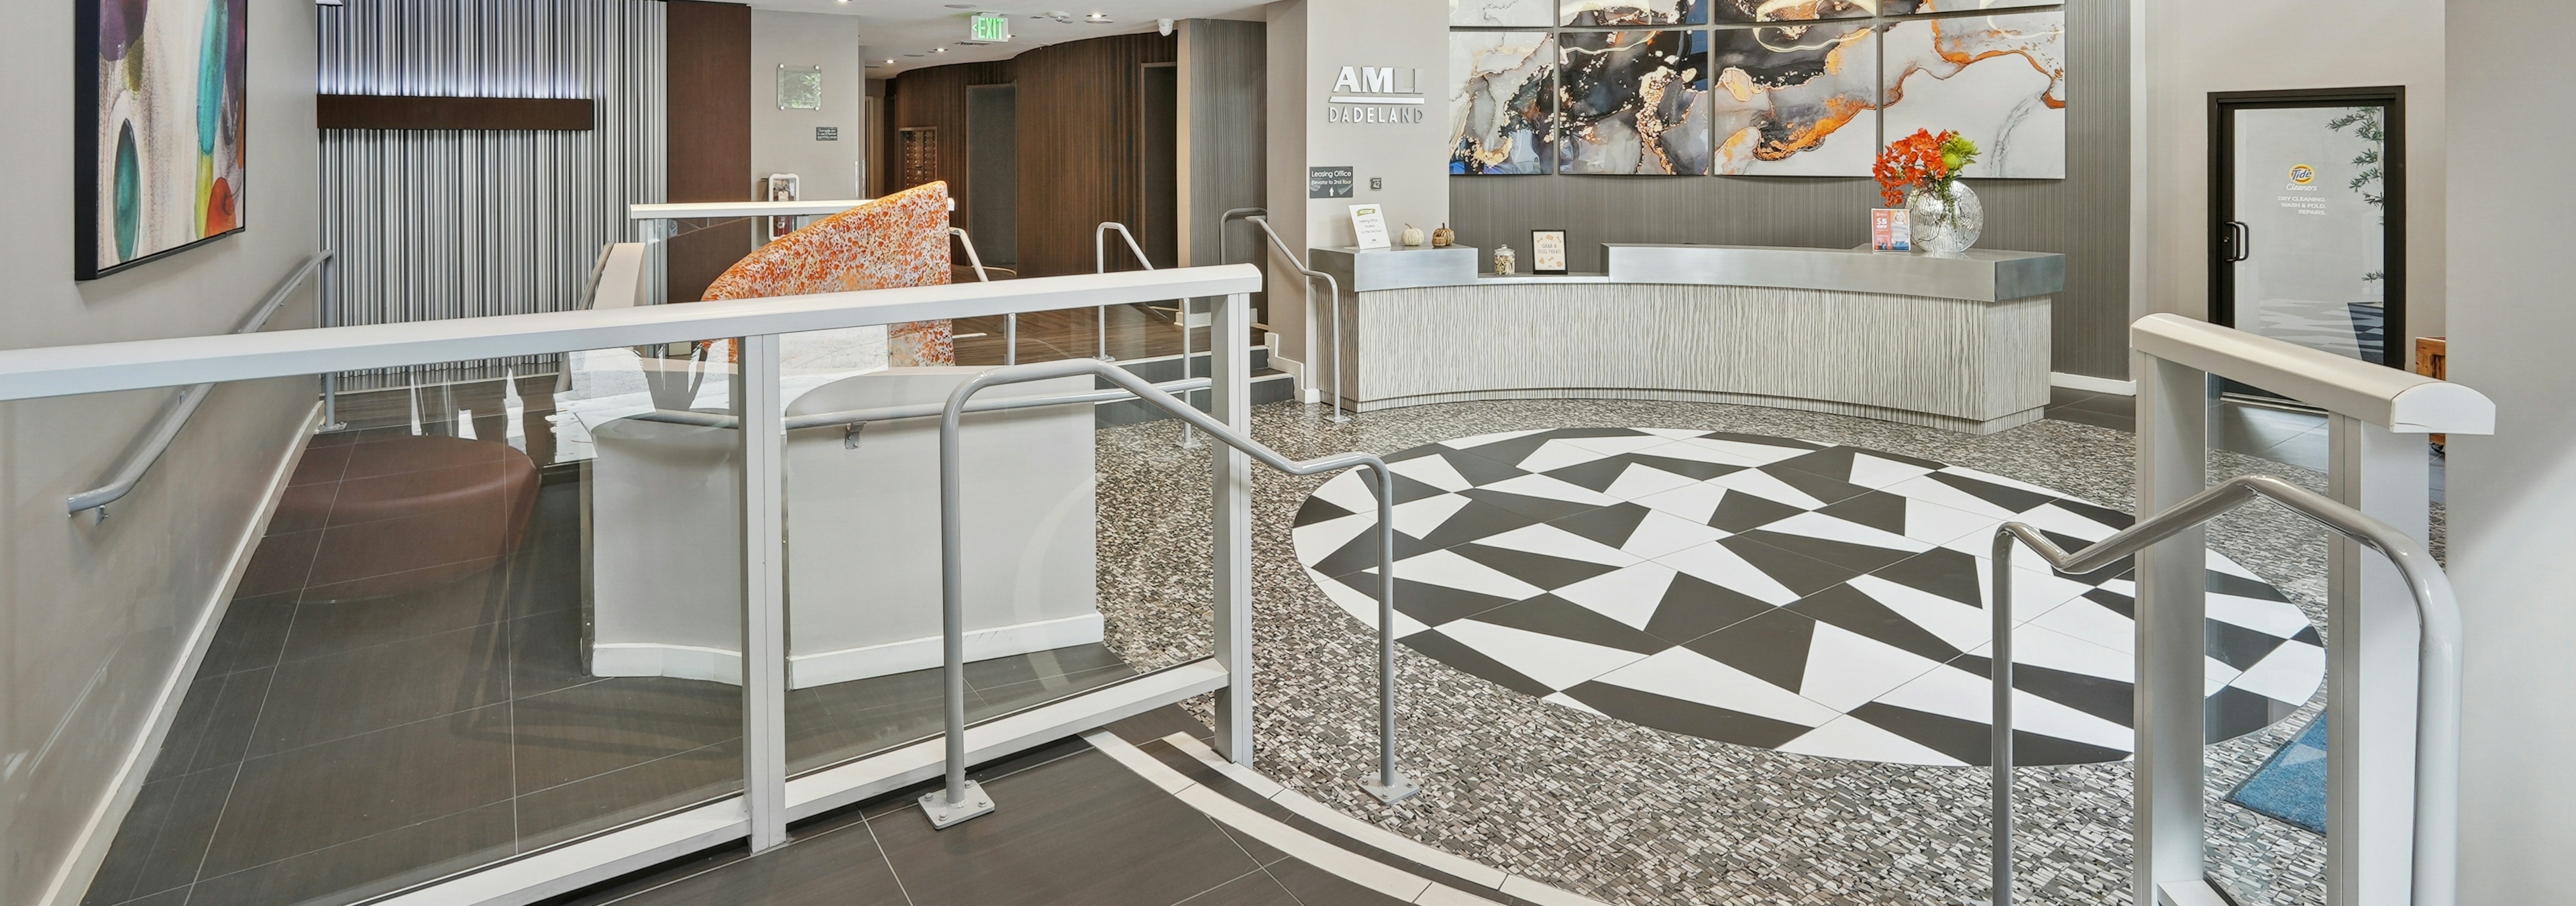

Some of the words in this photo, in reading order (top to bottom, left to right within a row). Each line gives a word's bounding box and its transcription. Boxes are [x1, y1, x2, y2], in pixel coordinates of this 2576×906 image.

[977, 17, 1004, 40] EXIT
[1332, 66, 1424, 94] AMLI
[1328, 106, 1424, 123] DADELAND
[1311, 170, 1333, 179] Leasing
[2292, 169, 2312, 181] Tide
[2286, 183, 2318, 191] Cleaners
